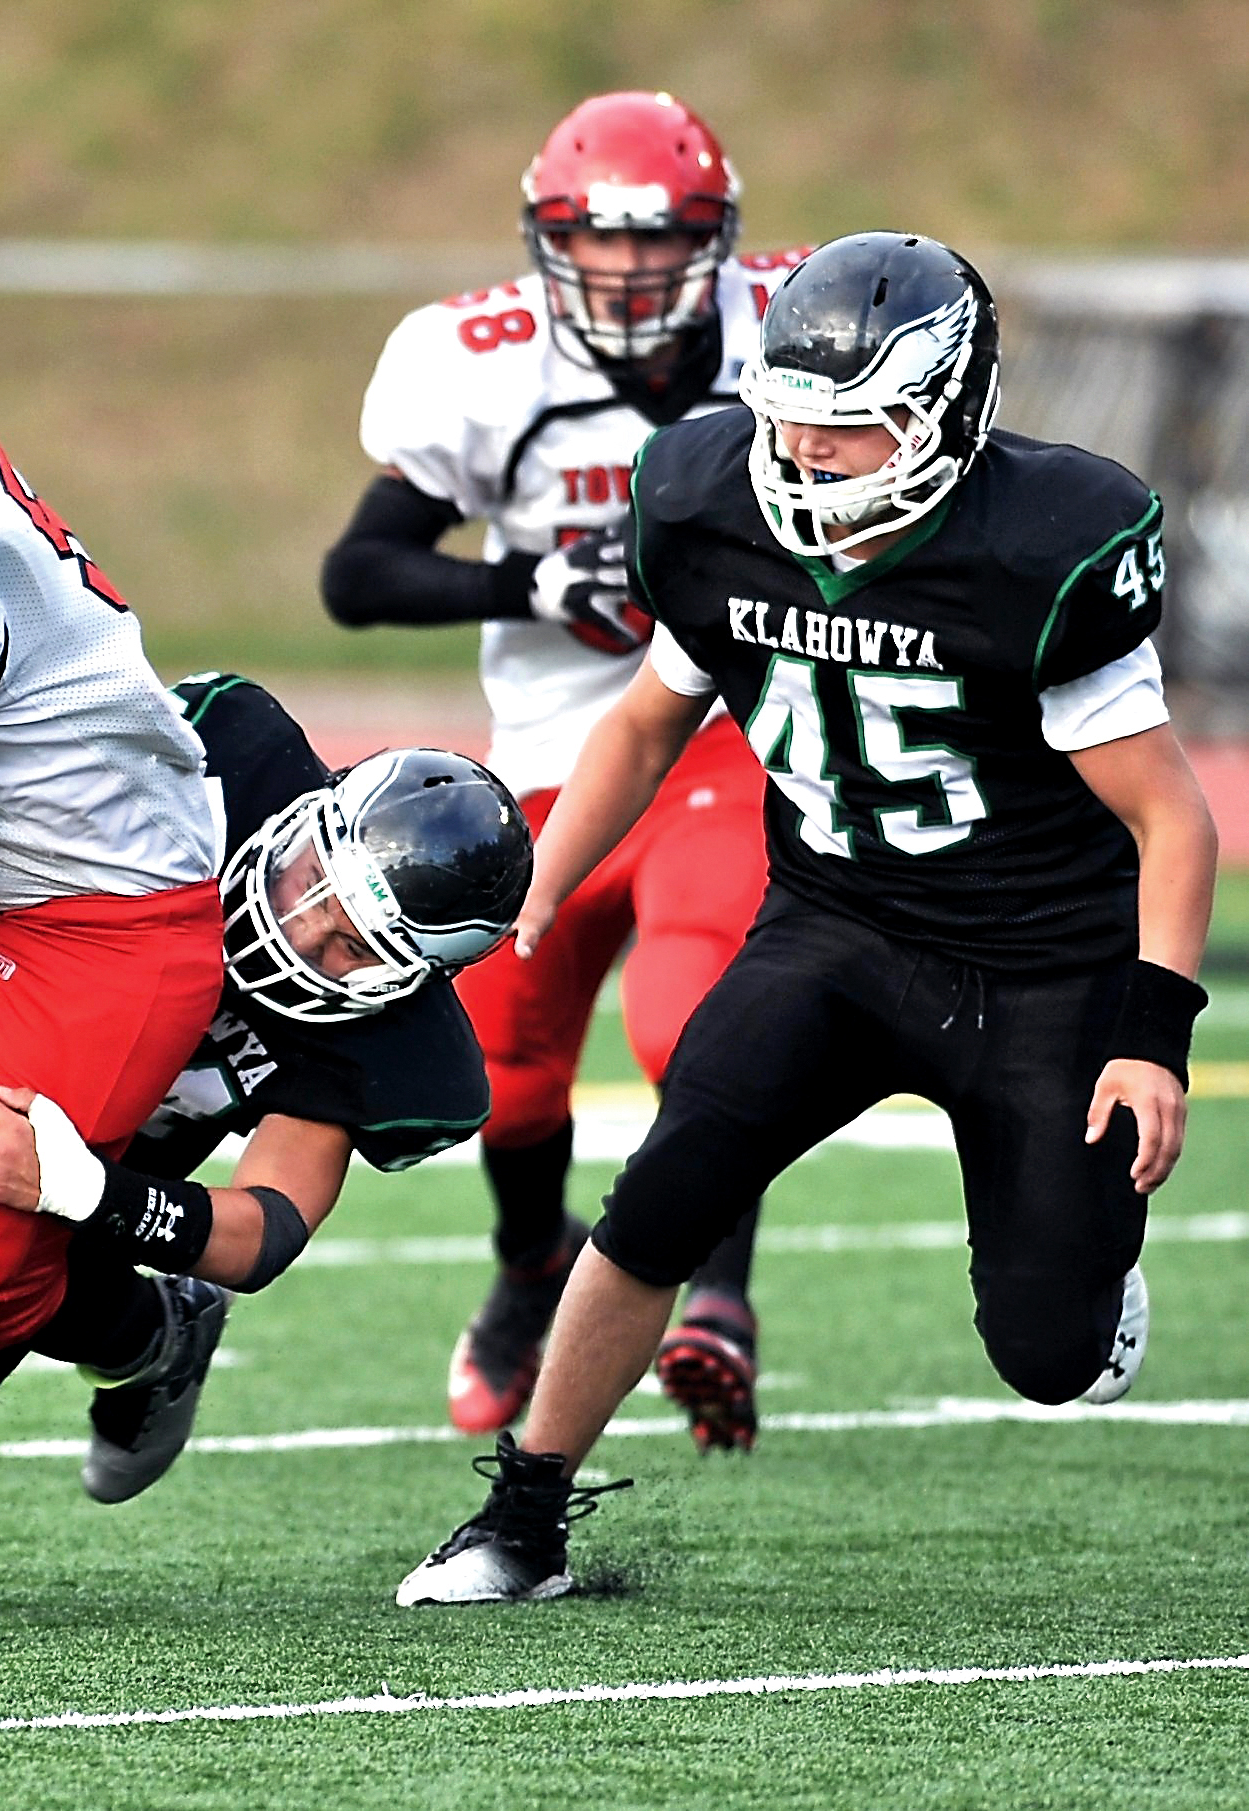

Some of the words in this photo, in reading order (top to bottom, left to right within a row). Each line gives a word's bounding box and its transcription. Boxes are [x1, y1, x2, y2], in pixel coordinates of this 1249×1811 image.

[781, 374, 813, 391] TEAM
[1111, 530, 1166, 612] 45
[727, 597, 944, 670] KLAHOWYA
[744, 653, 989, 861] 45
